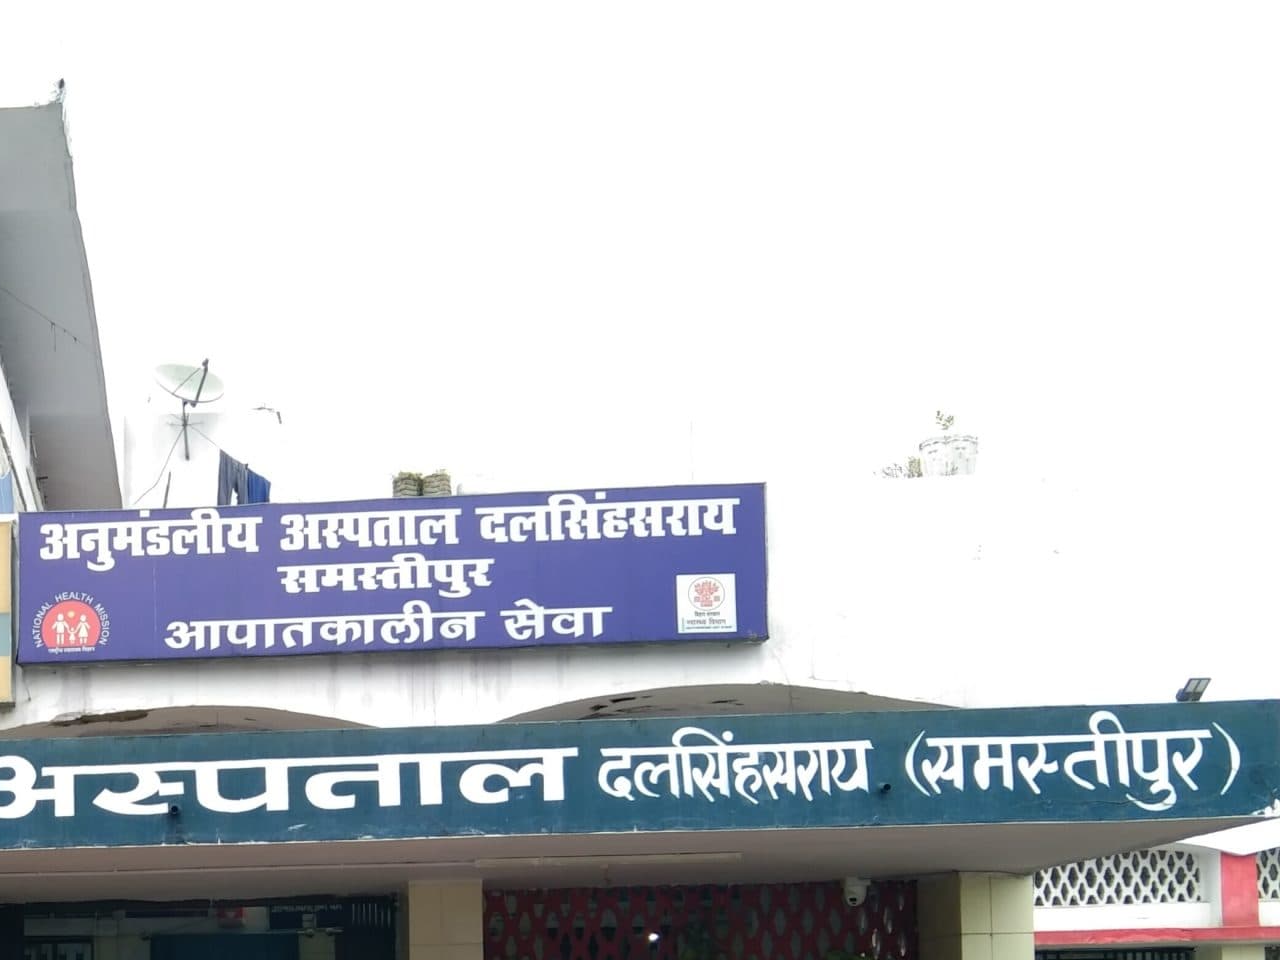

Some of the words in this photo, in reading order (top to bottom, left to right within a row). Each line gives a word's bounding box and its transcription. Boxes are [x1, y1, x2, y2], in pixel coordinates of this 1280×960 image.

[39, 508, 262, 571] अनुमंडलीय
[280, 506, 461, 551] अस्पताल
[475, 491, 740, 545] दलसिंहसराय
[277, 552, 494, 598] समस्तीपुर
[32, 602, 53, 648] NATIONAL
[55, 591, 94, 605] HEALTH
[94, 603, 110, 646] MISSION
[164, 600, 486, 652] आपातकालीन
[503, 598, 613, 640] सेवा
[598, 726, 874, 804] दलसिंहसराय
[905, 710, 1241, 812] (समस्तीपुर)
